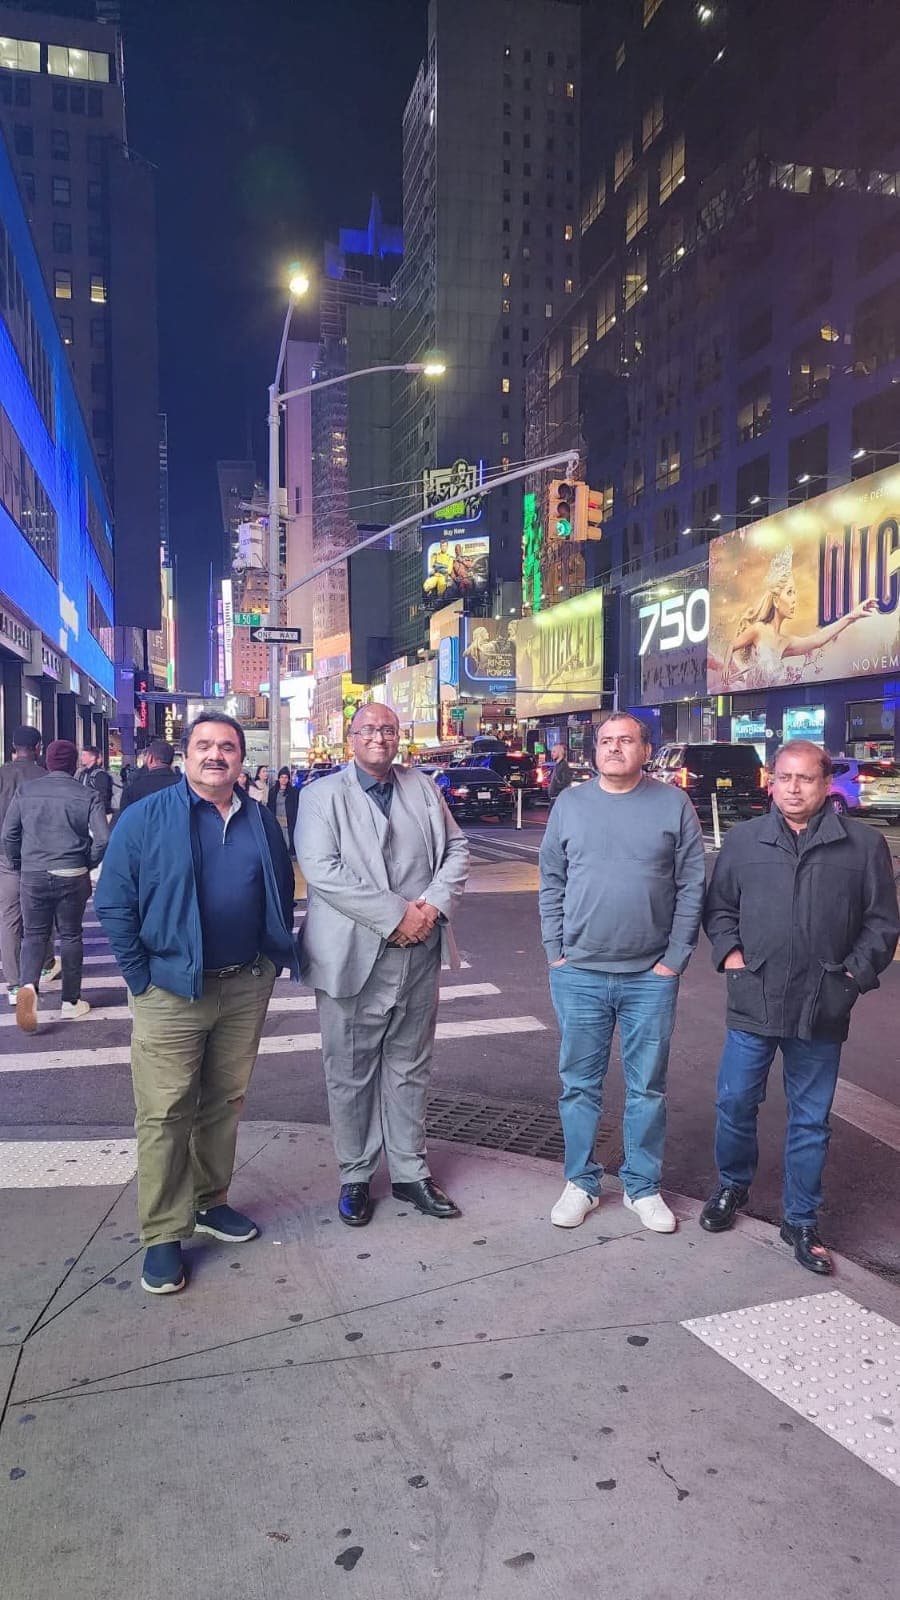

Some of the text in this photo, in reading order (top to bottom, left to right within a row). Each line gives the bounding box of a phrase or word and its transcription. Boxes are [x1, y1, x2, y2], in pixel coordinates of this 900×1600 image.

[443, 527, 465, 537] Buy Now
[242, 613, 250, 625] 50
[638, 588, 710, 656] 750
[257, 631, 296, 639] ONE WAY
[487, 658, 511, 667] KINGS
[852, 654, 900, 671] NOVEM
[486, 668, 512, 677] POWER
[164, 706, 174, 741] LAGOS
